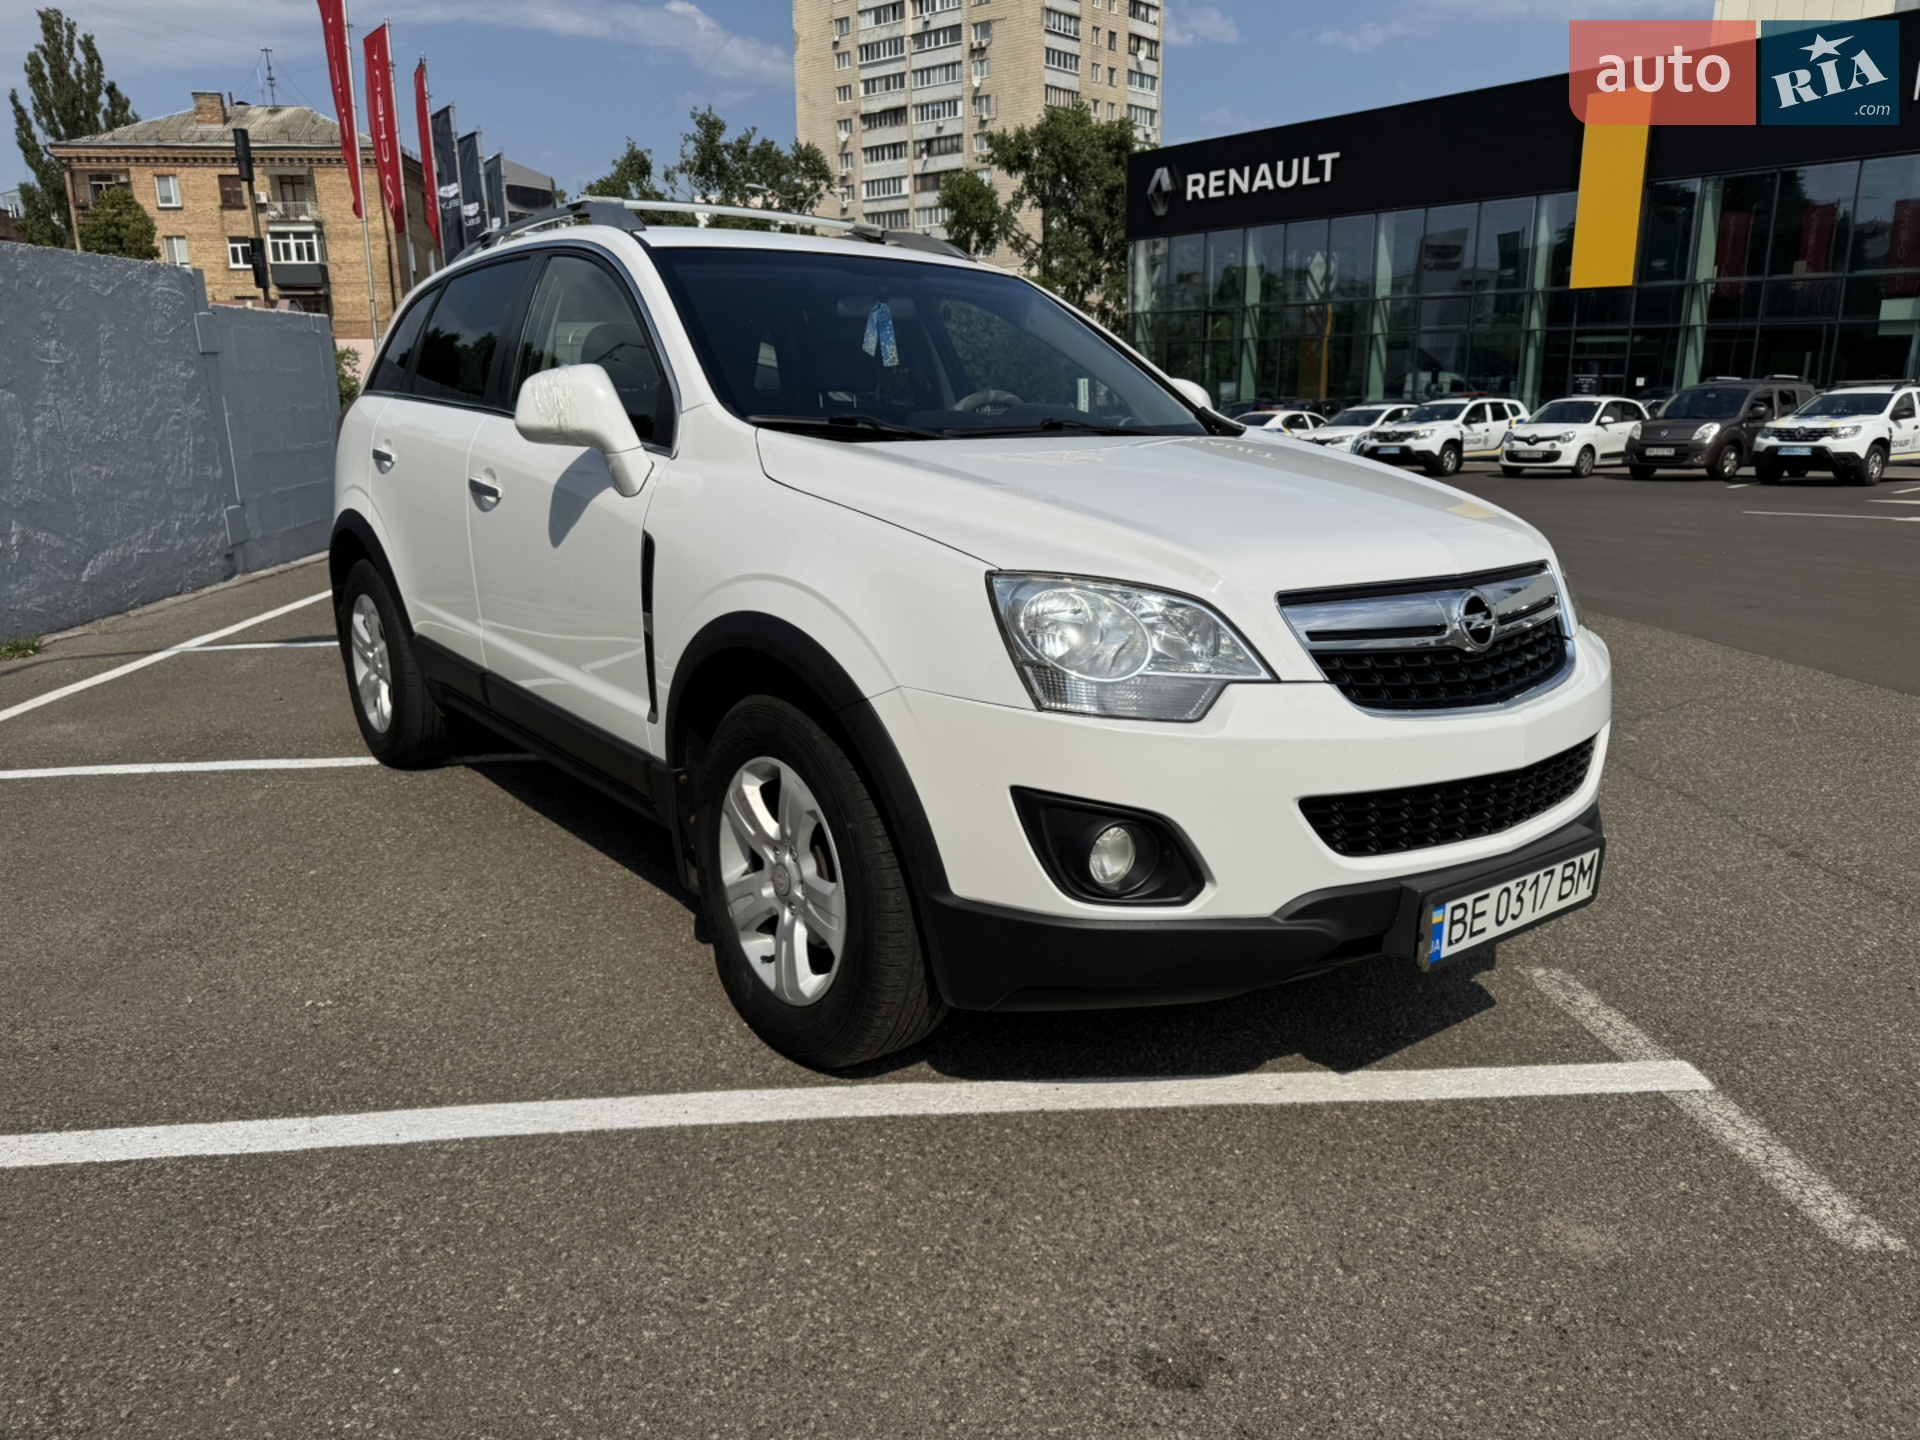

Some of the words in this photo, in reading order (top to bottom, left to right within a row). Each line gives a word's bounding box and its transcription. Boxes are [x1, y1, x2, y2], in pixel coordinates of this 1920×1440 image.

[1186, 151, 1341, 201] RENAULT
[1447, 893, 1491, 947] BE
[1495, 868, 1556, 927] 0317
[1557, 852, 1597, 902] BM
